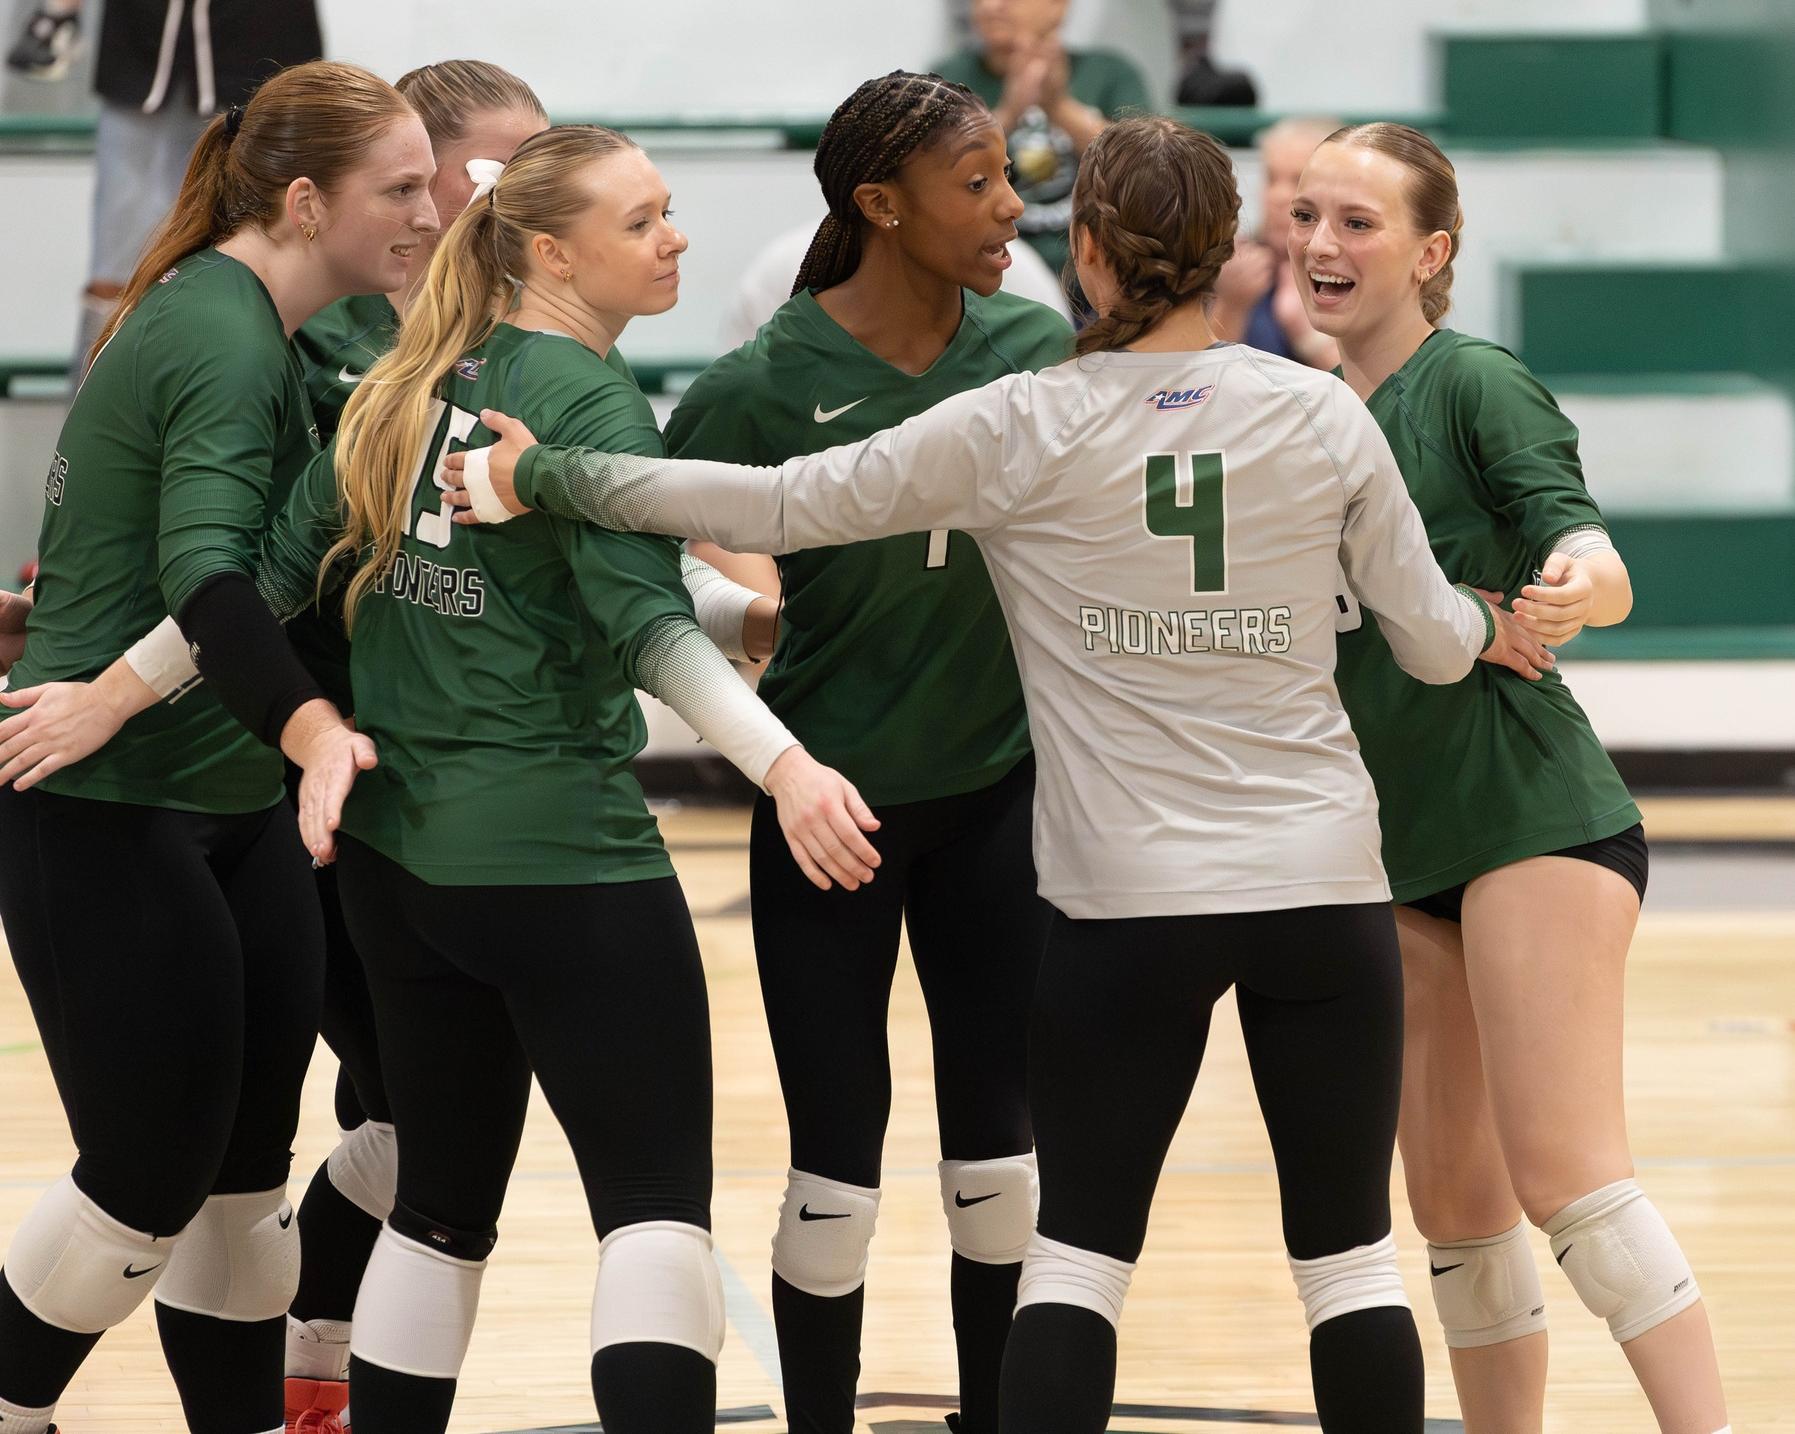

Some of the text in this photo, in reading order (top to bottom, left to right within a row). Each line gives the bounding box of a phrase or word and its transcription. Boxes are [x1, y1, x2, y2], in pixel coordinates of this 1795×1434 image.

[1145, 384, 1215, 411] AMC
[1142, 448, 1229, 596] 4
[1079, 605, 1292, 655] PIONEERS
